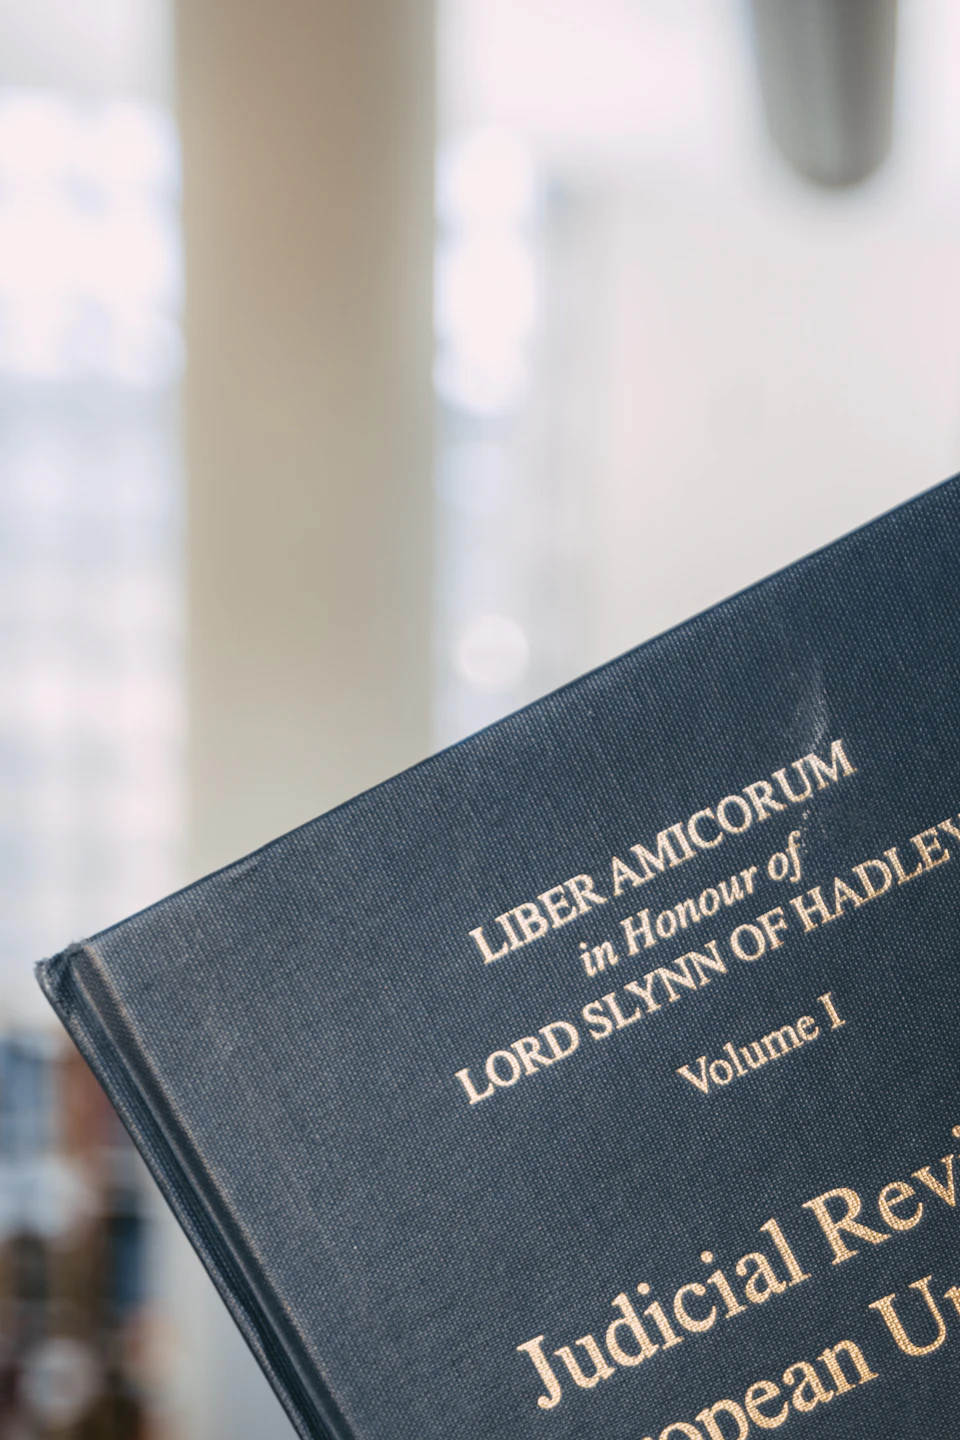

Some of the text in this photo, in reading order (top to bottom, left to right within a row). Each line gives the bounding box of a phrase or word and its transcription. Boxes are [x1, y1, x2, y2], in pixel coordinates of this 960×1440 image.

[468, 738, 858, 966] LIBER AMICORUM
[579, 830, 805, 977] in Honour of
[454, 1020, 580, 1106] LORD
[582, 941, 728, 1041] SLYNN
[729, 908, 785, 962] OF
[676, 992, 847, 1095] Volume I
[516, 1217, 811, 1411] Judicial
